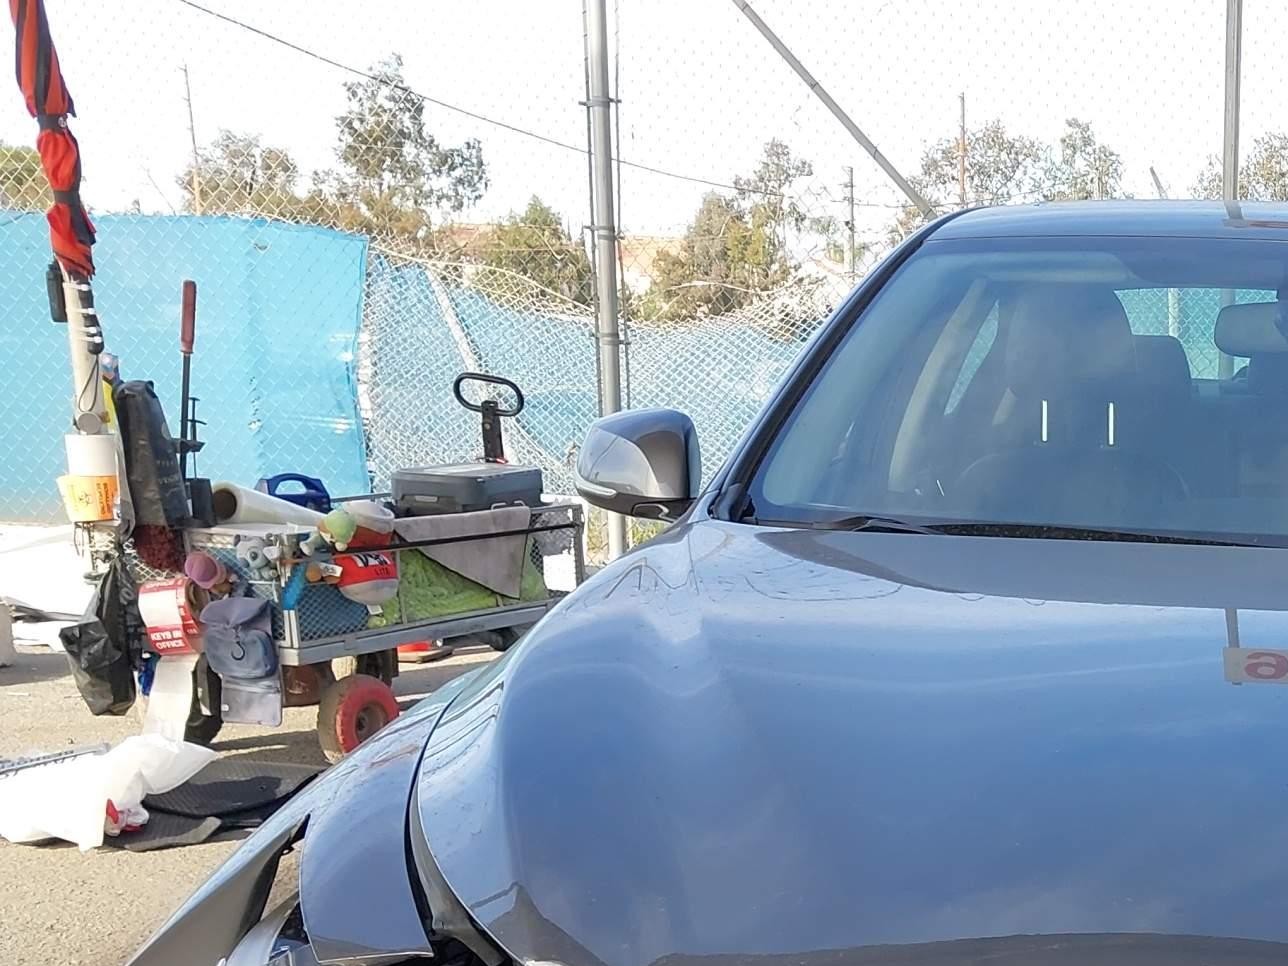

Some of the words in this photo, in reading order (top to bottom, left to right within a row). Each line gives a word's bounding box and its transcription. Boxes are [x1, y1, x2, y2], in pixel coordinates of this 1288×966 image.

[150, 631, 172, 641] KEYS
[172, 630, 182, 639] IN
[156, 640, 185, 650] OFFICE
